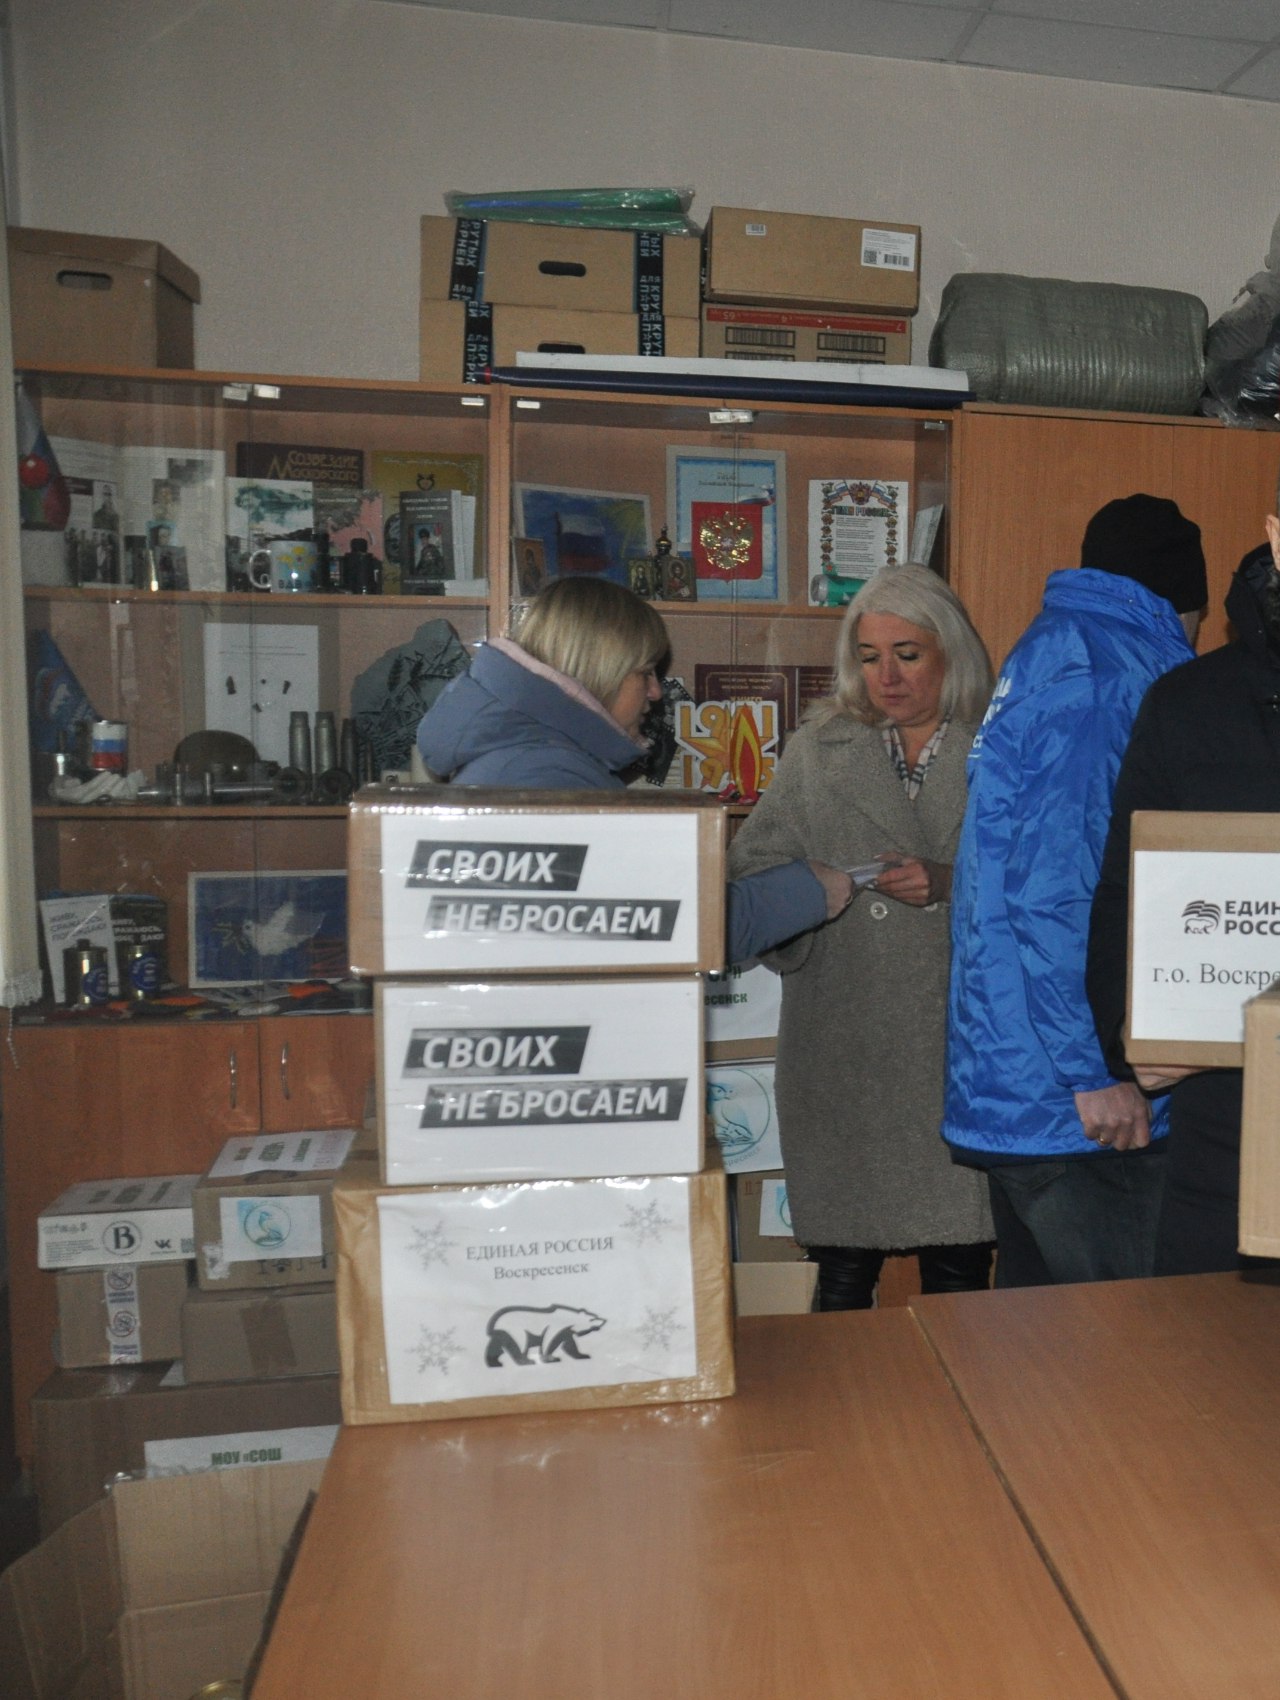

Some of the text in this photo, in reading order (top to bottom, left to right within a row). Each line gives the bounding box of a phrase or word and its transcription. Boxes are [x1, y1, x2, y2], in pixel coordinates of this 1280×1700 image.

[465, 221, 482, 268] РУТЫХ
[651, 323, 663, 356] КРУТ
[680, 704, 775, 740] 191
[682, 754, 776, 790] 195
[426, 849, 559, 884] СВОИХ
[444, 903, 662, 934] НЕ БРОСАЕМ
[1152, 967, 1191, 984] г.о.
[423, 1035, 560, 1069] СВОИХ
[440, 1086, 668, 1121] НЕ БРОСАЕМ
[465, 1235, 615, 1262] ЕДИНАЯ РОССИЯ
[493, 1261, 590, 1282] Воскресенск
